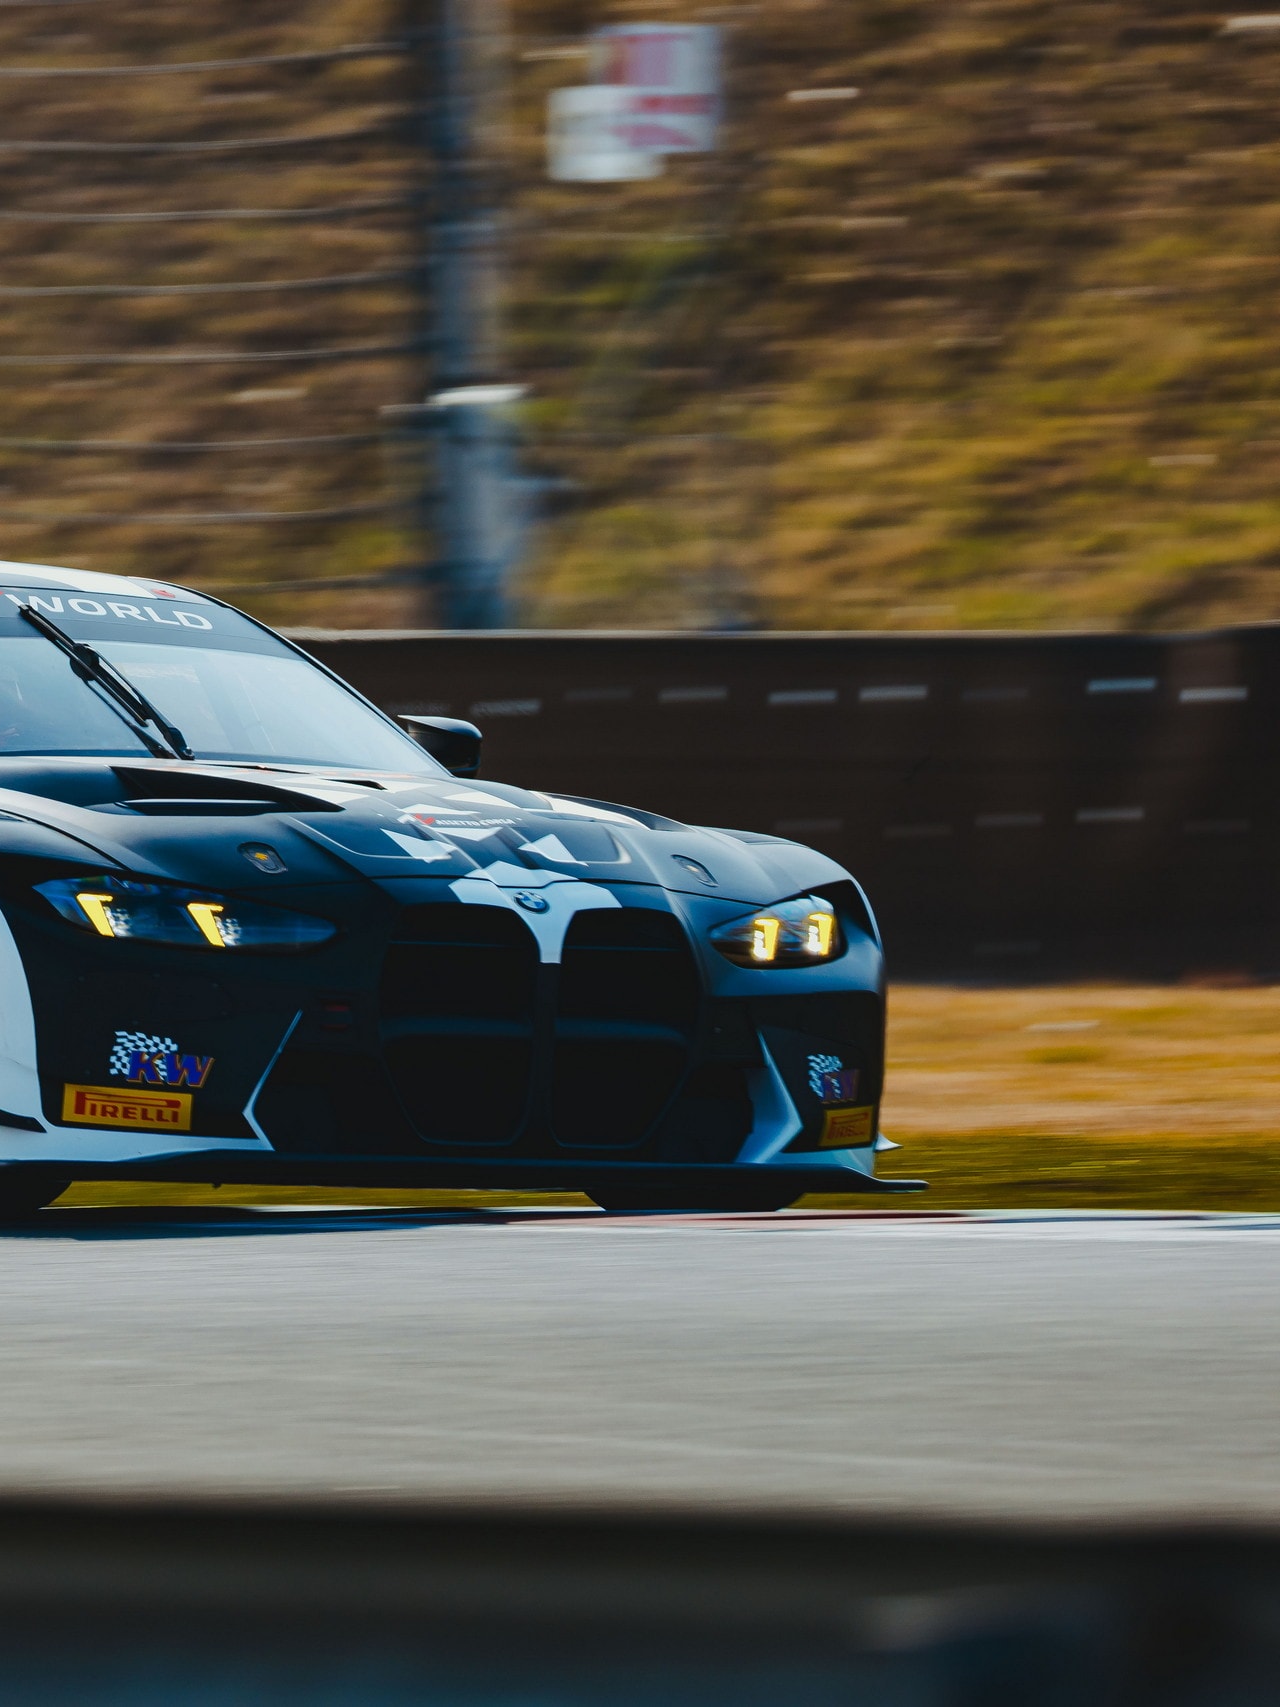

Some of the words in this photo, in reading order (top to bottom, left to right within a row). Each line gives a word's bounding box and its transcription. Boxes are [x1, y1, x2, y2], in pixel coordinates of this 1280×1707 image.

[5, 593, 213, 631] WORLD
[126, 1050, 216, 1088] KW
[73, 1090, 182, 1123] PIRELLI
